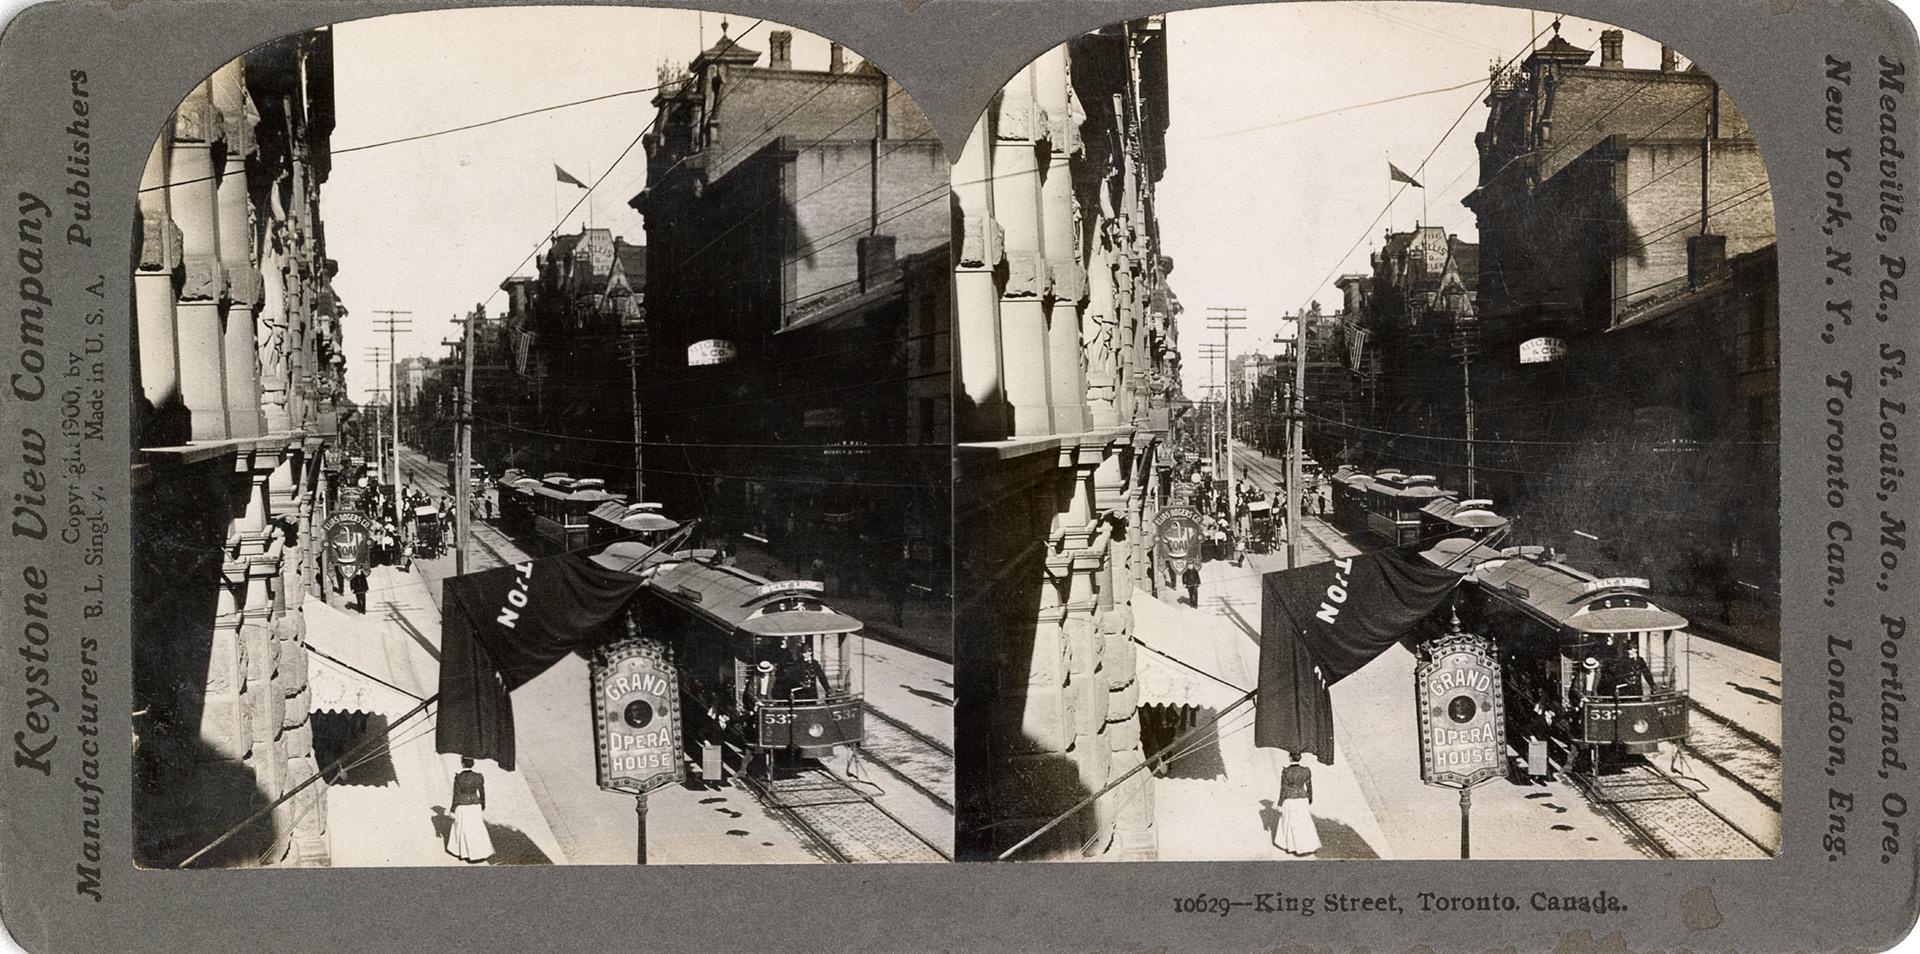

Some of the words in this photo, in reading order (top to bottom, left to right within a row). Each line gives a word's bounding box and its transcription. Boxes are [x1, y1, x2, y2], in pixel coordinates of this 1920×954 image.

[605, 673, 668, 701] GRAND
[1429, 669, 1491, 697] GRAND
[610, 726, 672, 753] OPERA
[1434, 722, 1495, 747] OPERA
[613, 753, 672, 772] HOUSE
[1437, 748, 1495, 767] HOUSE
